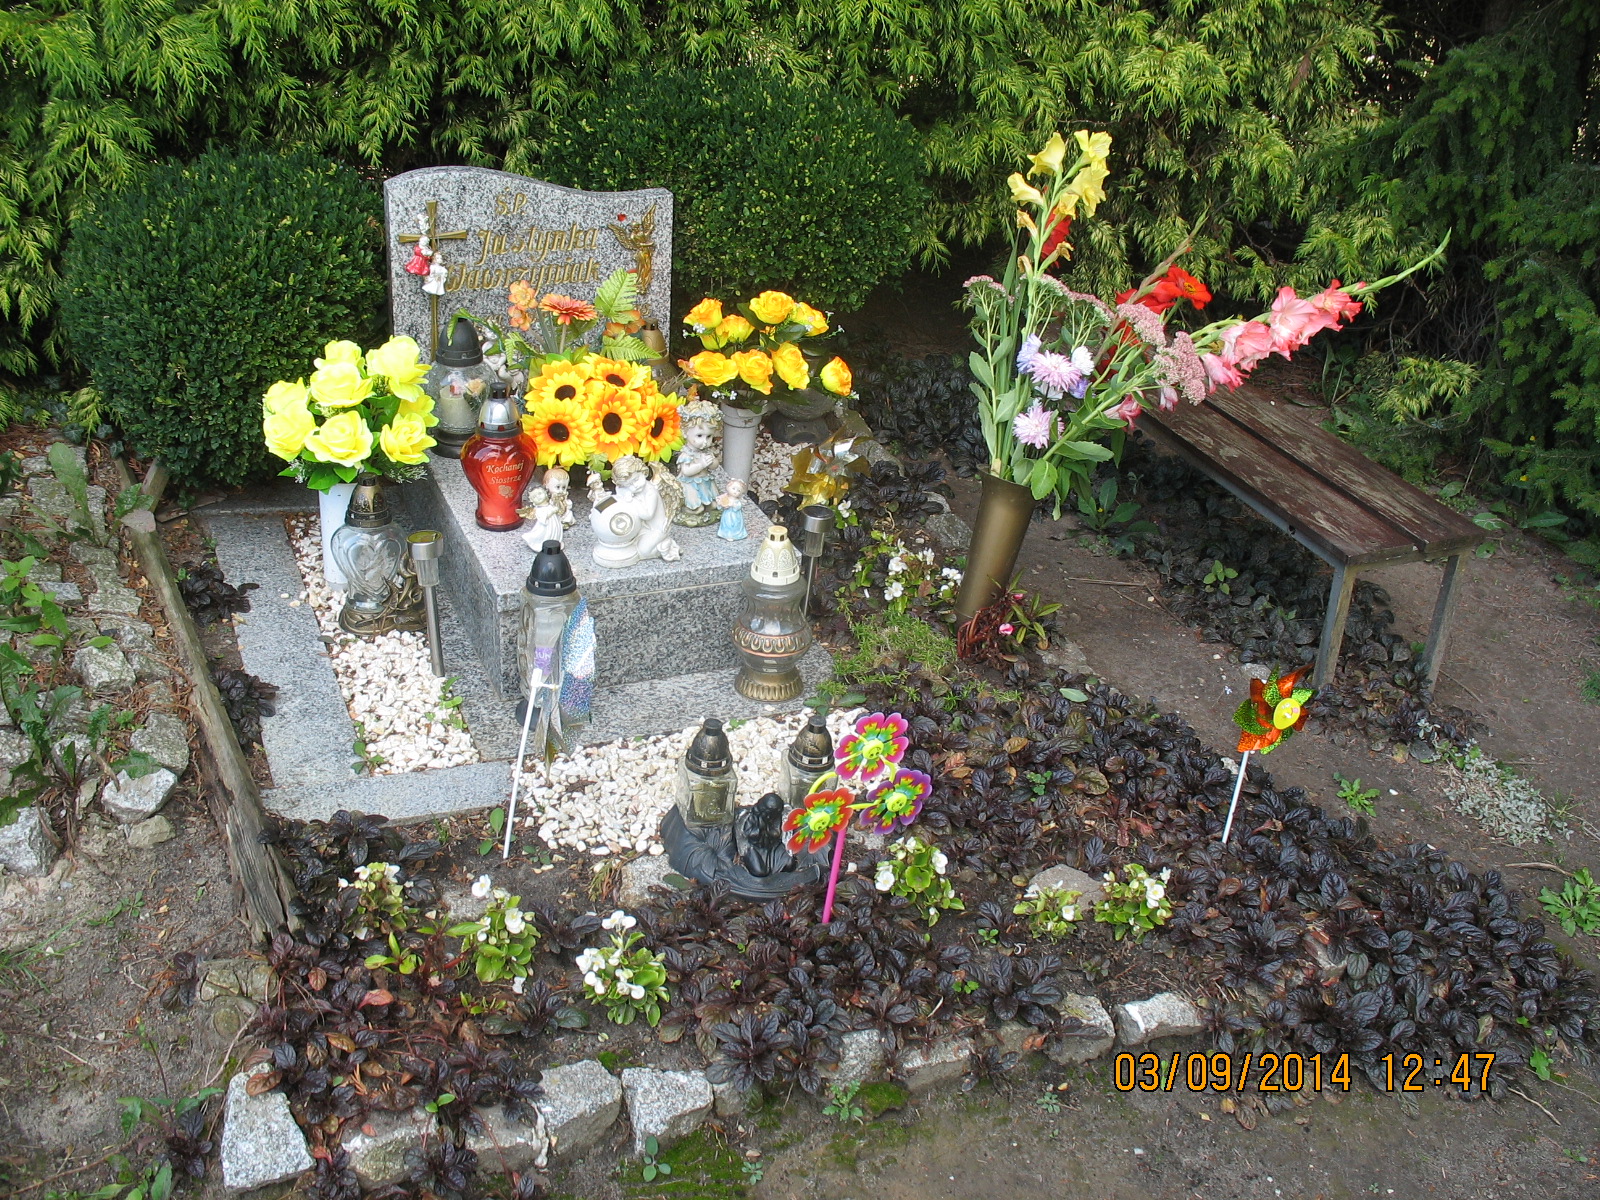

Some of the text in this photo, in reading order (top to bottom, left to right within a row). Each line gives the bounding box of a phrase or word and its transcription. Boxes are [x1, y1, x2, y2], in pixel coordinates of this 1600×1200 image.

[475, 222, 600, 267] Justynka
[446, 257, 601, 298] Wawrzyniak
[485, 459, 525, 475] Kochanej
[489, 474, 522, 485] Siostrze
